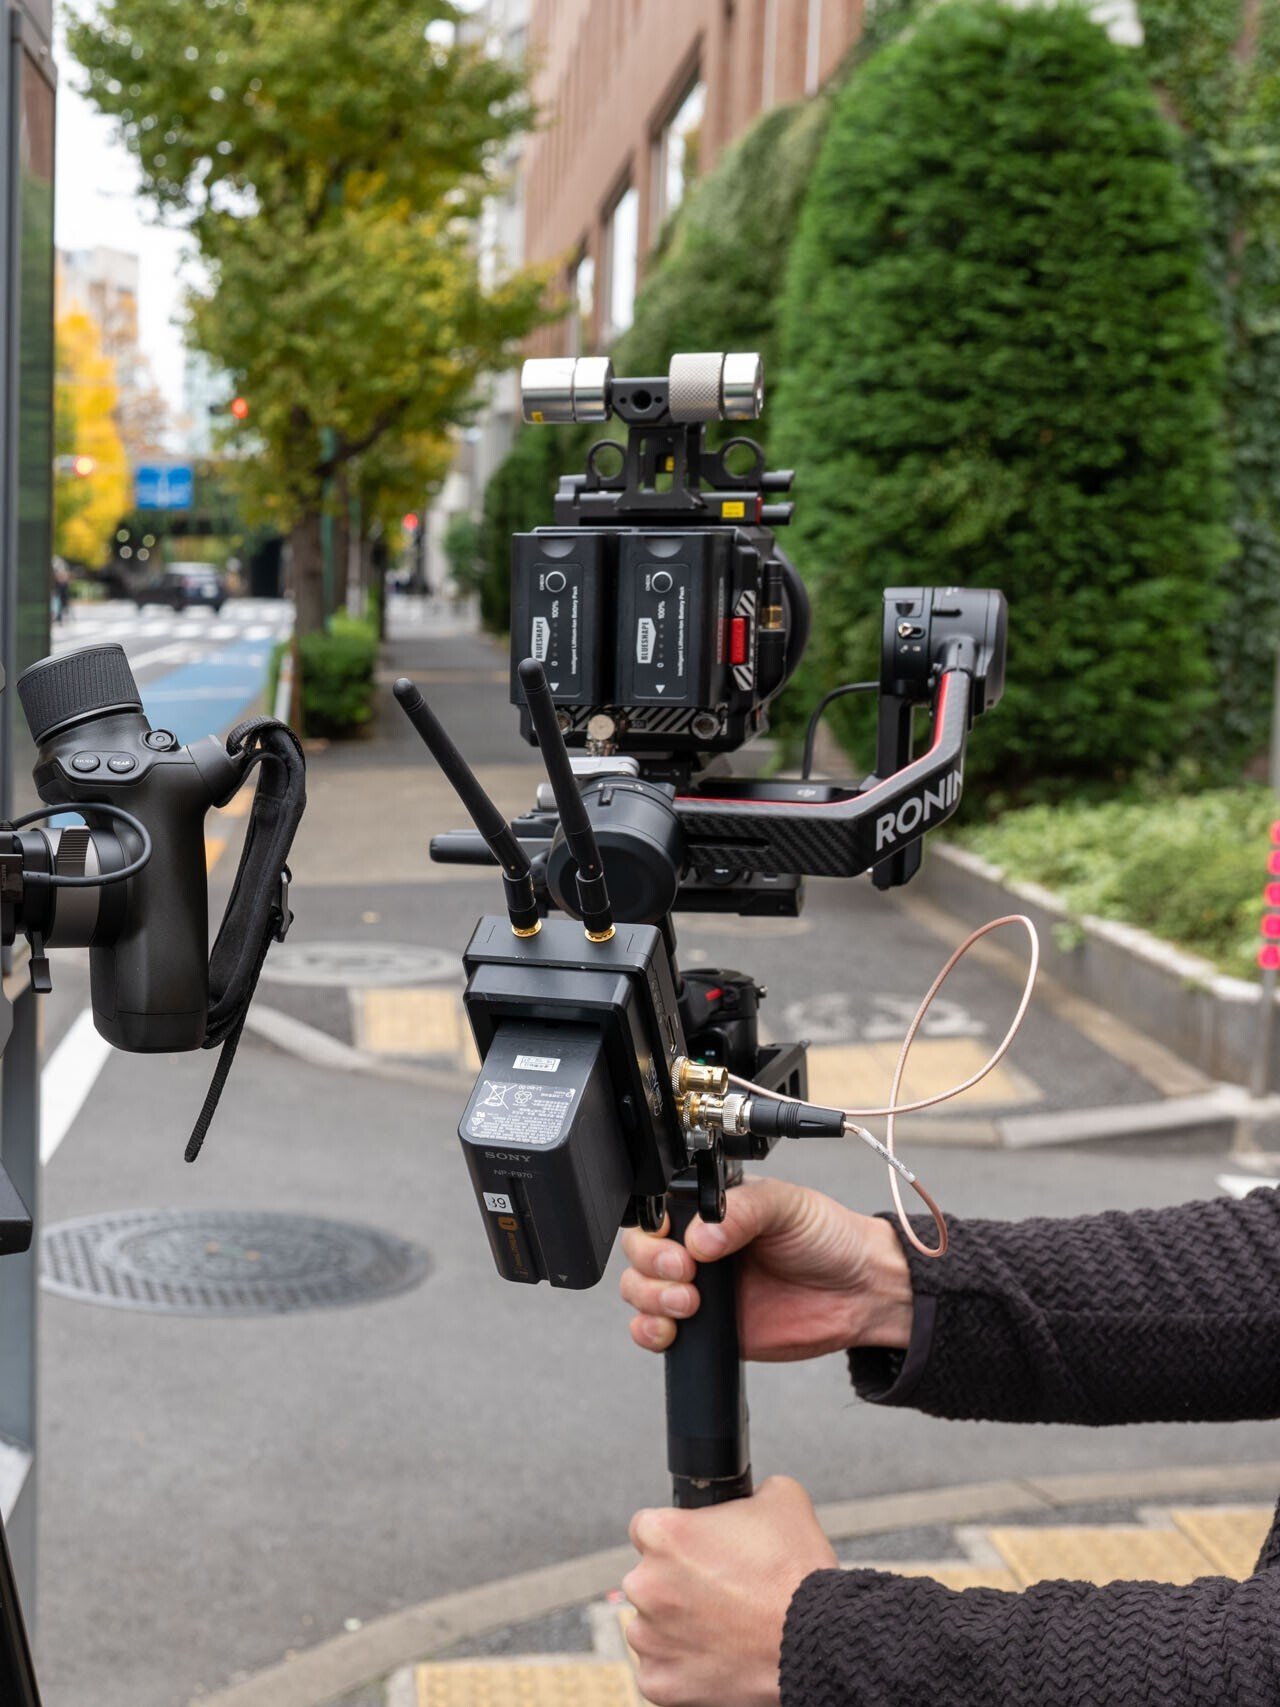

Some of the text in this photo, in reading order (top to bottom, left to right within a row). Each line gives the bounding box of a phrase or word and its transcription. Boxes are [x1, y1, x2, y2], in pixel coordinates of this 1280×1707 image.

[551, 600, 559, 618] 100%
[535, 621, 544, 659] BLUESHAPE
[641, 621, 649, 661] BLUESHAPE
[876, 769, 963, 852] RONIN
[484, 1151, 532, 1162] SONY
[493, 1169, 533, 1179] NP-F970
